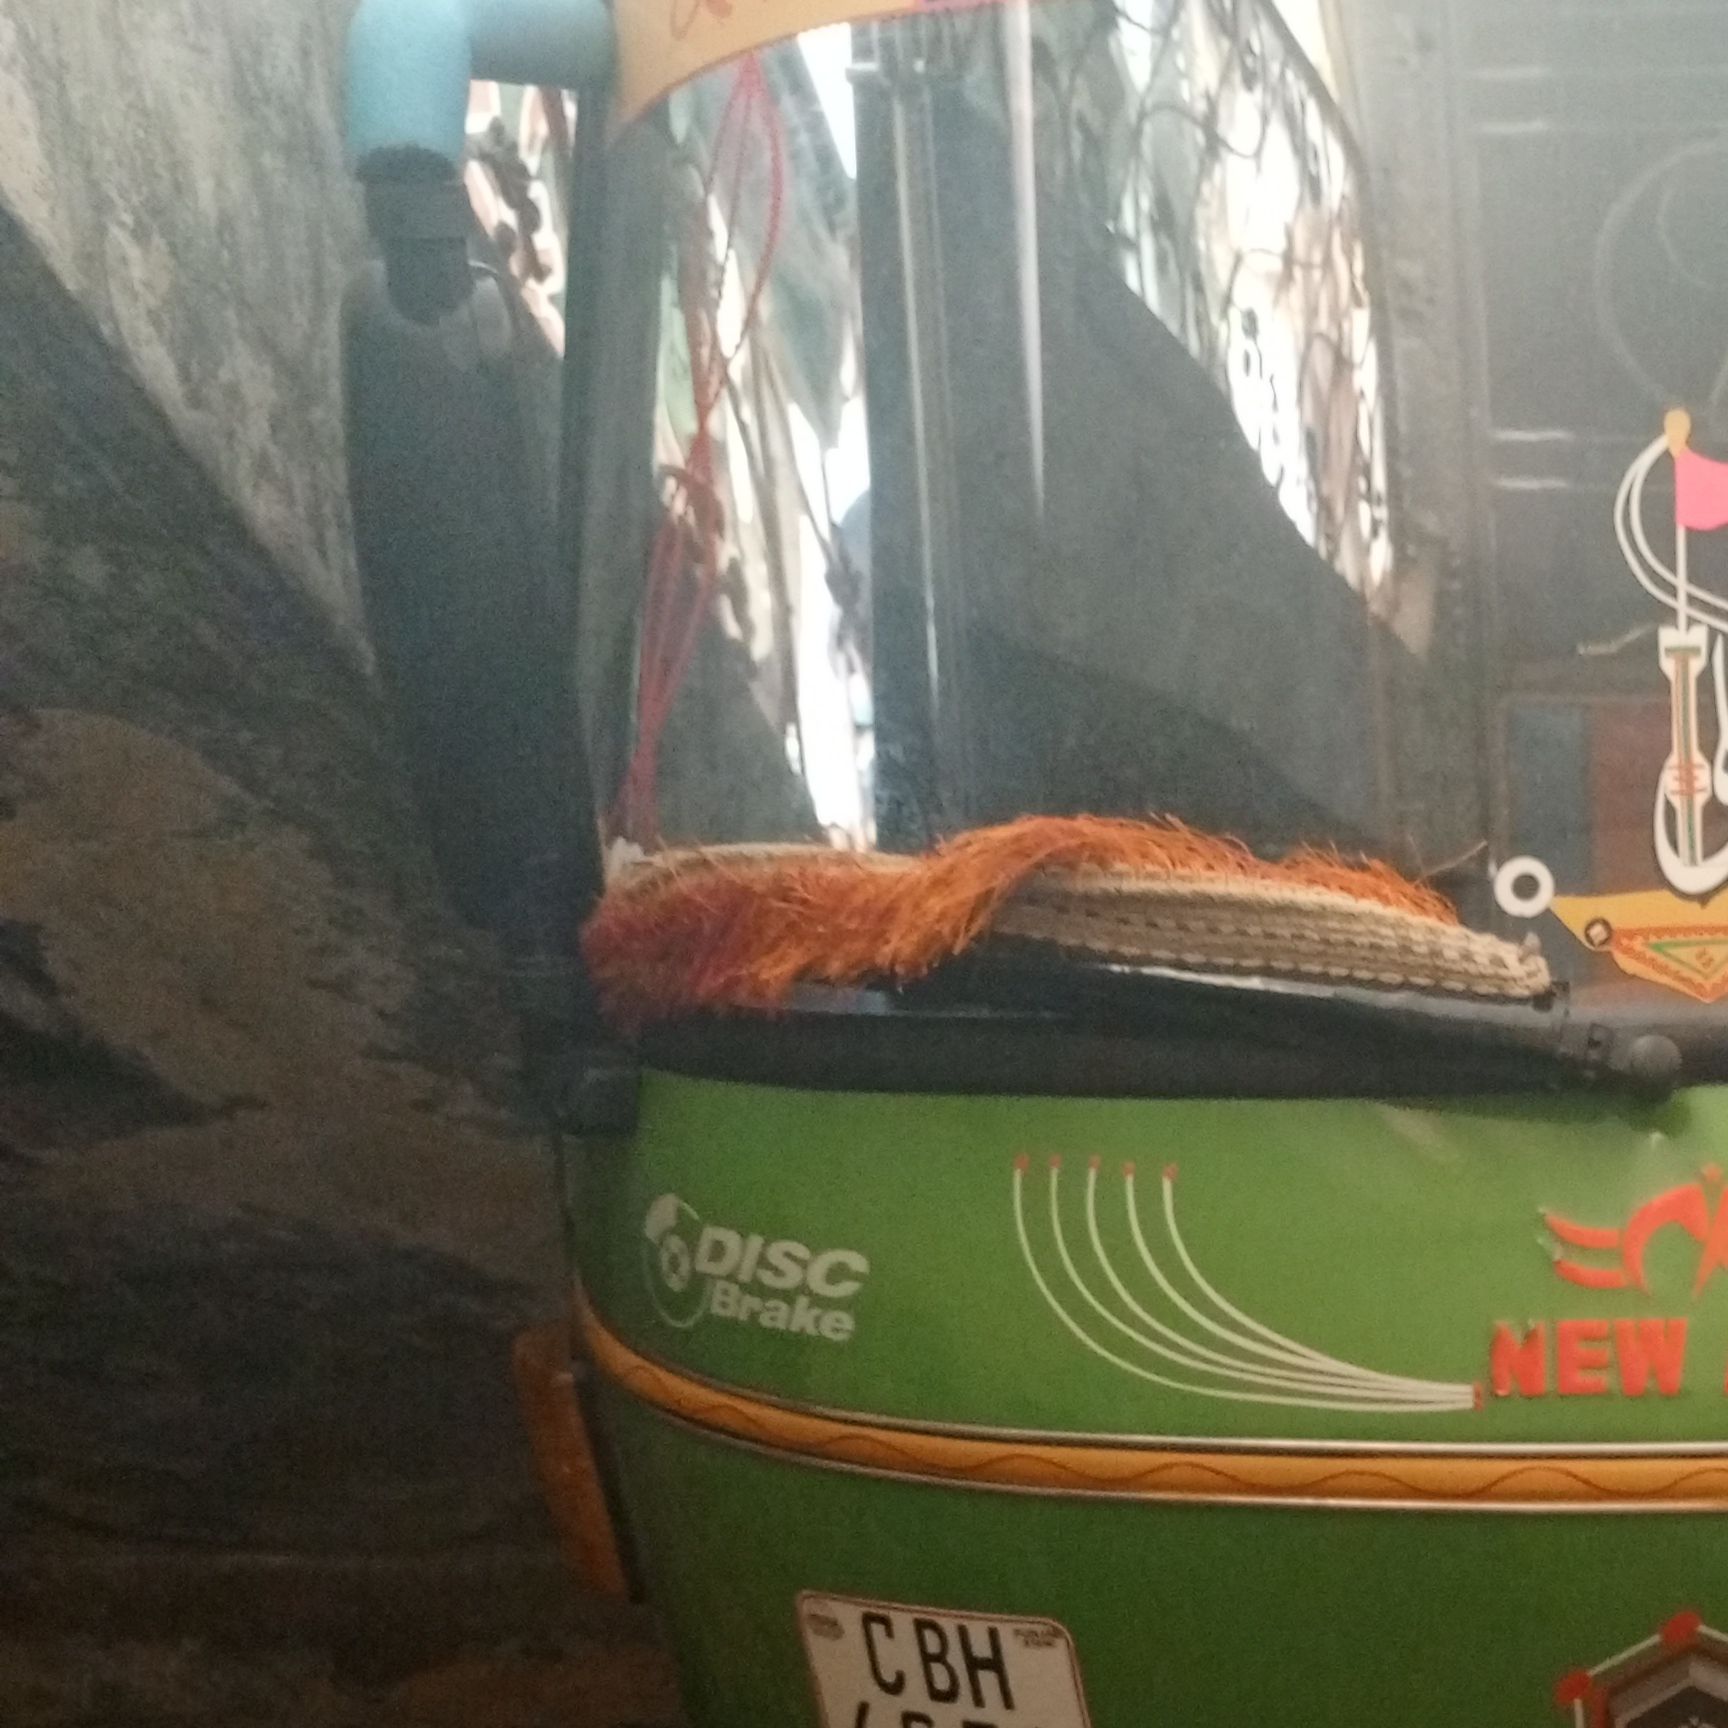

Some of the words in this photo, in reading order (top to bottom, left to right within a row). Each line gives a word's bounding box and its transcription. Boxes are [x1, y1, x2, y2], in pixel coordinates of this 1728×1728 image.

[695, 1226, 871, 1298] DISC
[709, 1280, 856, 1342] Brake
[1490, 1318, 1689, 1397] NEW
[861, 1611, 1015, 1710] CBH
